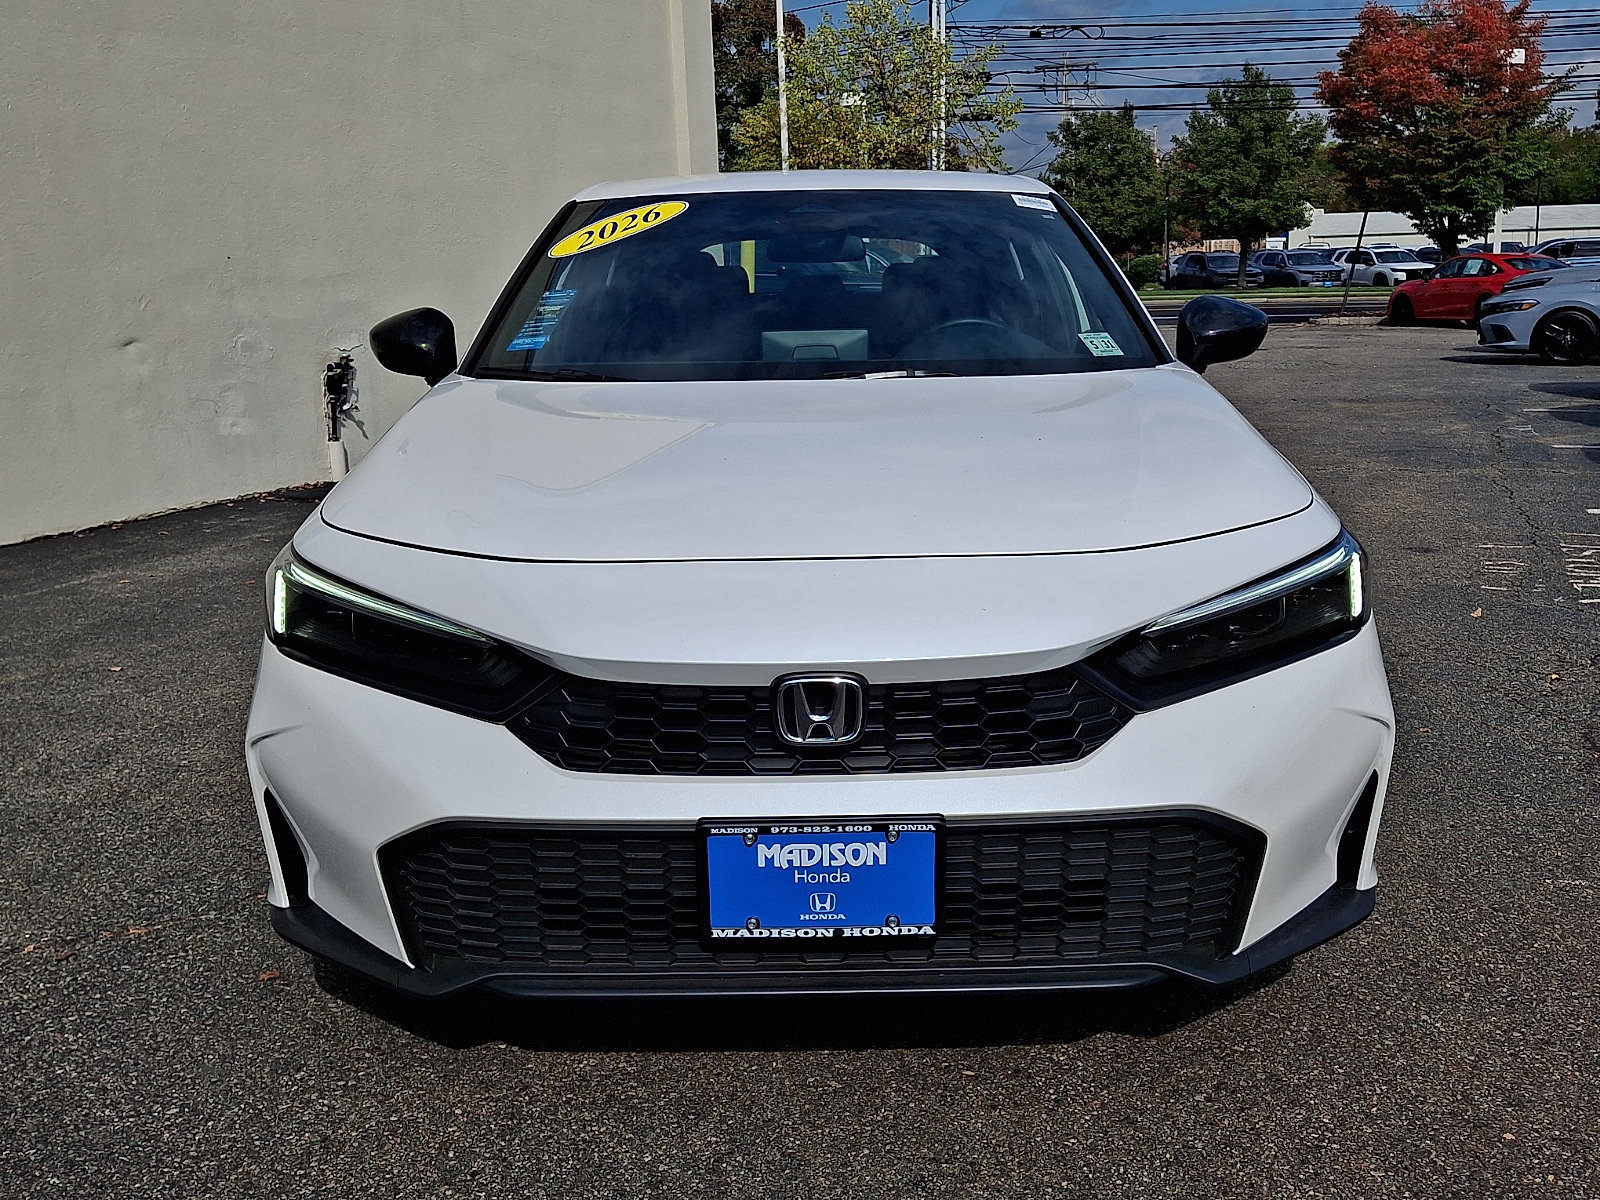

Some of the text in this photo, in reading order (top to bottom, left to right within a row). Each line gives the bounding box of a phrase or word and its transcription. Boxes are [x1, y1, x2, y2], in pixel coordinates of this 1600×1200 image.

[576, 205, 662, 251] 2026
[1089, 340, 1115, 349] 5 31
[770, 825, 872, 833] 973-822-1600
[757, 841, 887, 870] MADISON
[794, 868, 851, 884] Honda
[710, 925, 936, 938] MADISON HONDA
